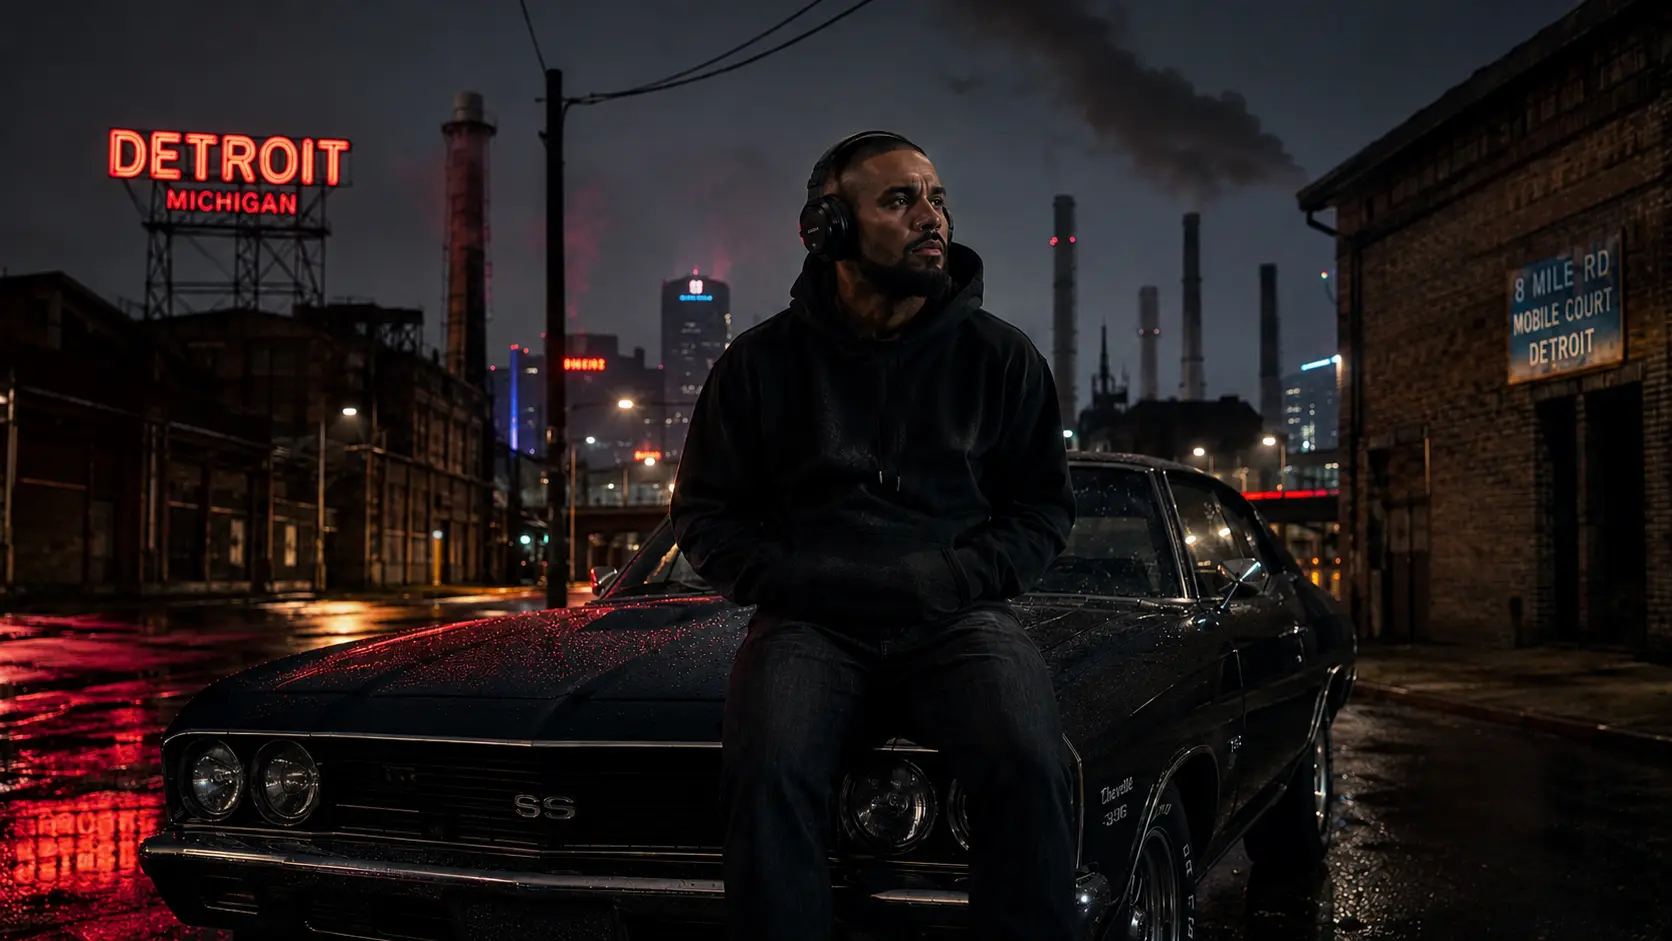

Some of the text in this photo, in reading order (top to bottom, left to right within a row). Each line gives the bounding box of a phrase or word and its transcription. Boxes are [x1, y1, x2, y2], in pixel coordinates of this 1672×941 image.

[107, 127, 351, 187] DETROIT
[166, 187, 298, 216] MICHIGAN
[1514, 249, 1610, 303] 8 MILE RD
[1513, 286, 1613, 337] MOBILE COURT
[1529, 327, 1595, 367] DETROIT
[514, 794, 576, 820] SS
